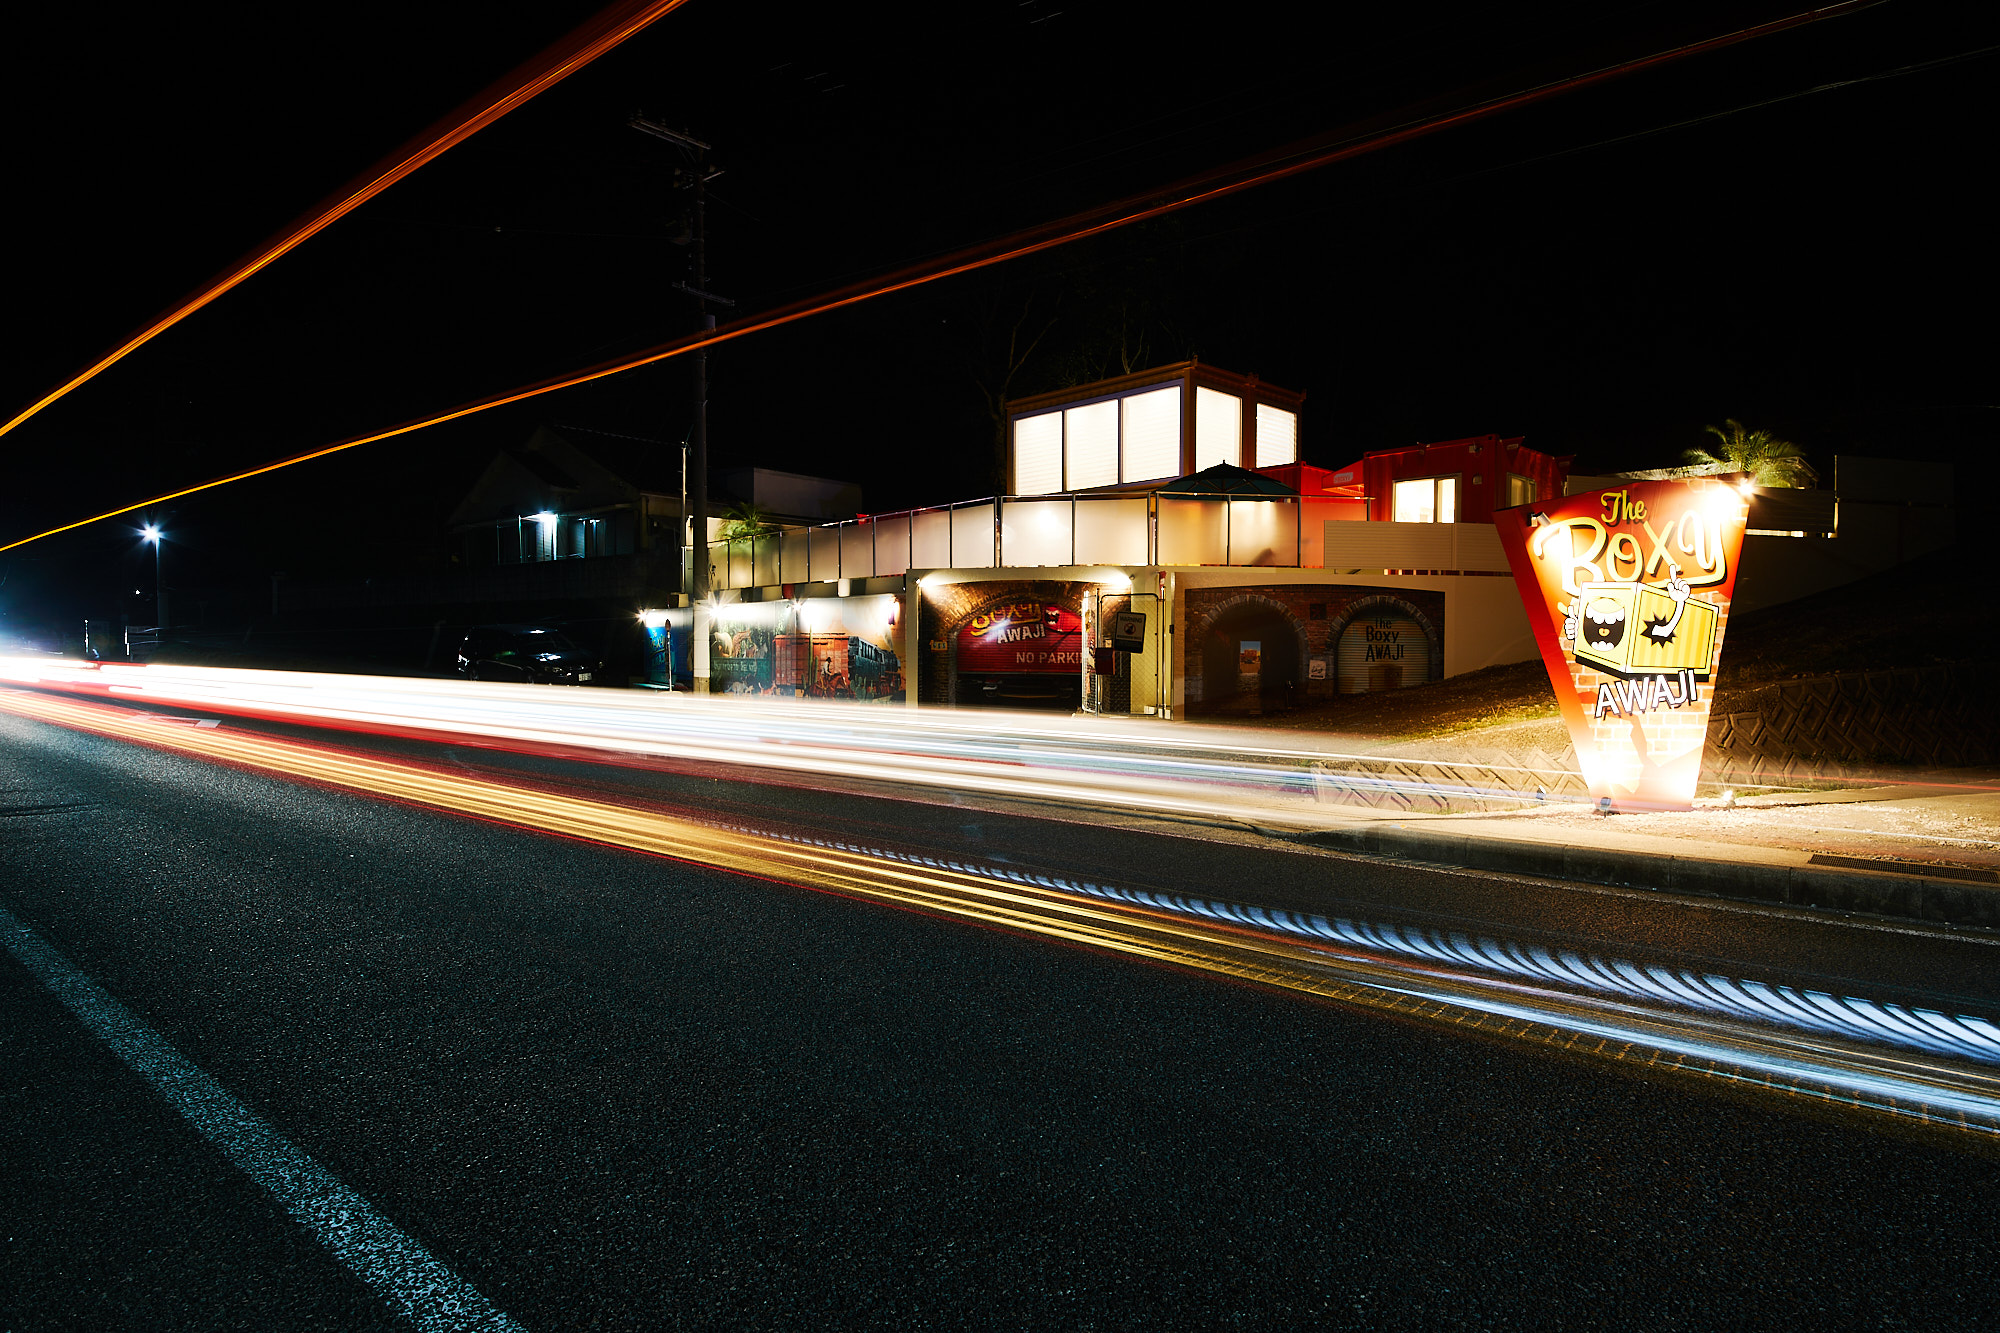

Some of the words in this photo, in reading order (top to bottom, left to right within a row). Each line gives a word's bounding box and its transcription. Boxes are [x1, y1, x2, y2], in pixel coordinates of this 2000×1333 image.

[1600, 489, 1648, 524] The
[1119, 615, 1142, 624] WARNING
[1375, 617, 1393, 631] The
[996, 623, 1046, 645] AWAJI
[1366, 625, 1399, 643] Boxy
[1016, 651, 1035, 664] NO
[1365, 644, 1405, 662] AWAJI
[1593, 668, 1698, 720] AWAJI
